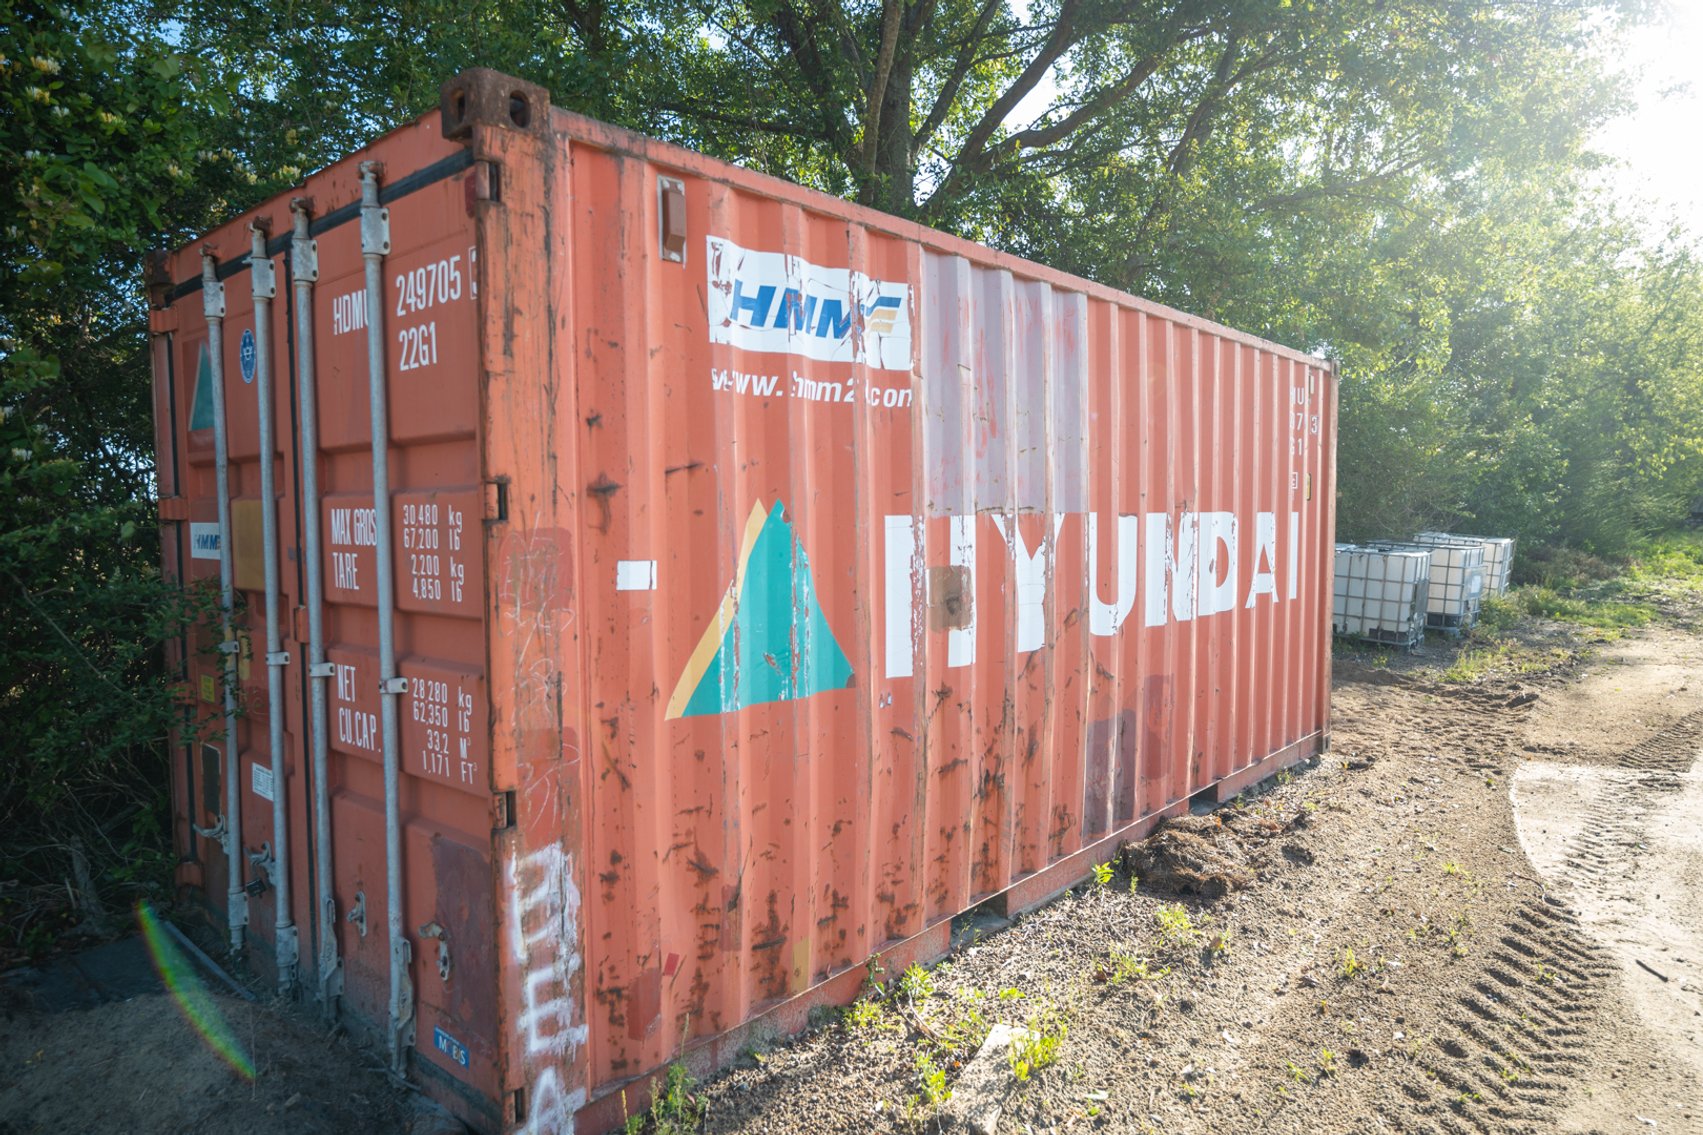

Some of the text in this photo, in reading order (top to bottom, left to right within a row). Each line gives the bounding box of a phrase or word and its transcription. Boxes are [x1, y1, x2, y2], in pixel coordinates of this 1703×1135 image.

[396, 255, 461, 317] 249705
[730, 279, 853, 340] HMM
[399, 322, 438, 371] 22G1
[331, 508, 352, 546] MAX
[403, 504, 463, 533] 30,480 kg
[404, 528, 438, 550] 67,200
[332, 552, 360, 590] TARE
[411, 554, 464, 586] 2,200 kg
[413, 578, 441, 600] 4,850
[885, 511, 1299, 679] HYUNDAI
[337, 664, 356, 703] NET
[413, 677, 472, 716] 28,280 kg
[413, 700, 448, 727] 62,350
[427, 729, 449, 754] 33.2
[422, 750, 450, 777] 1,171
